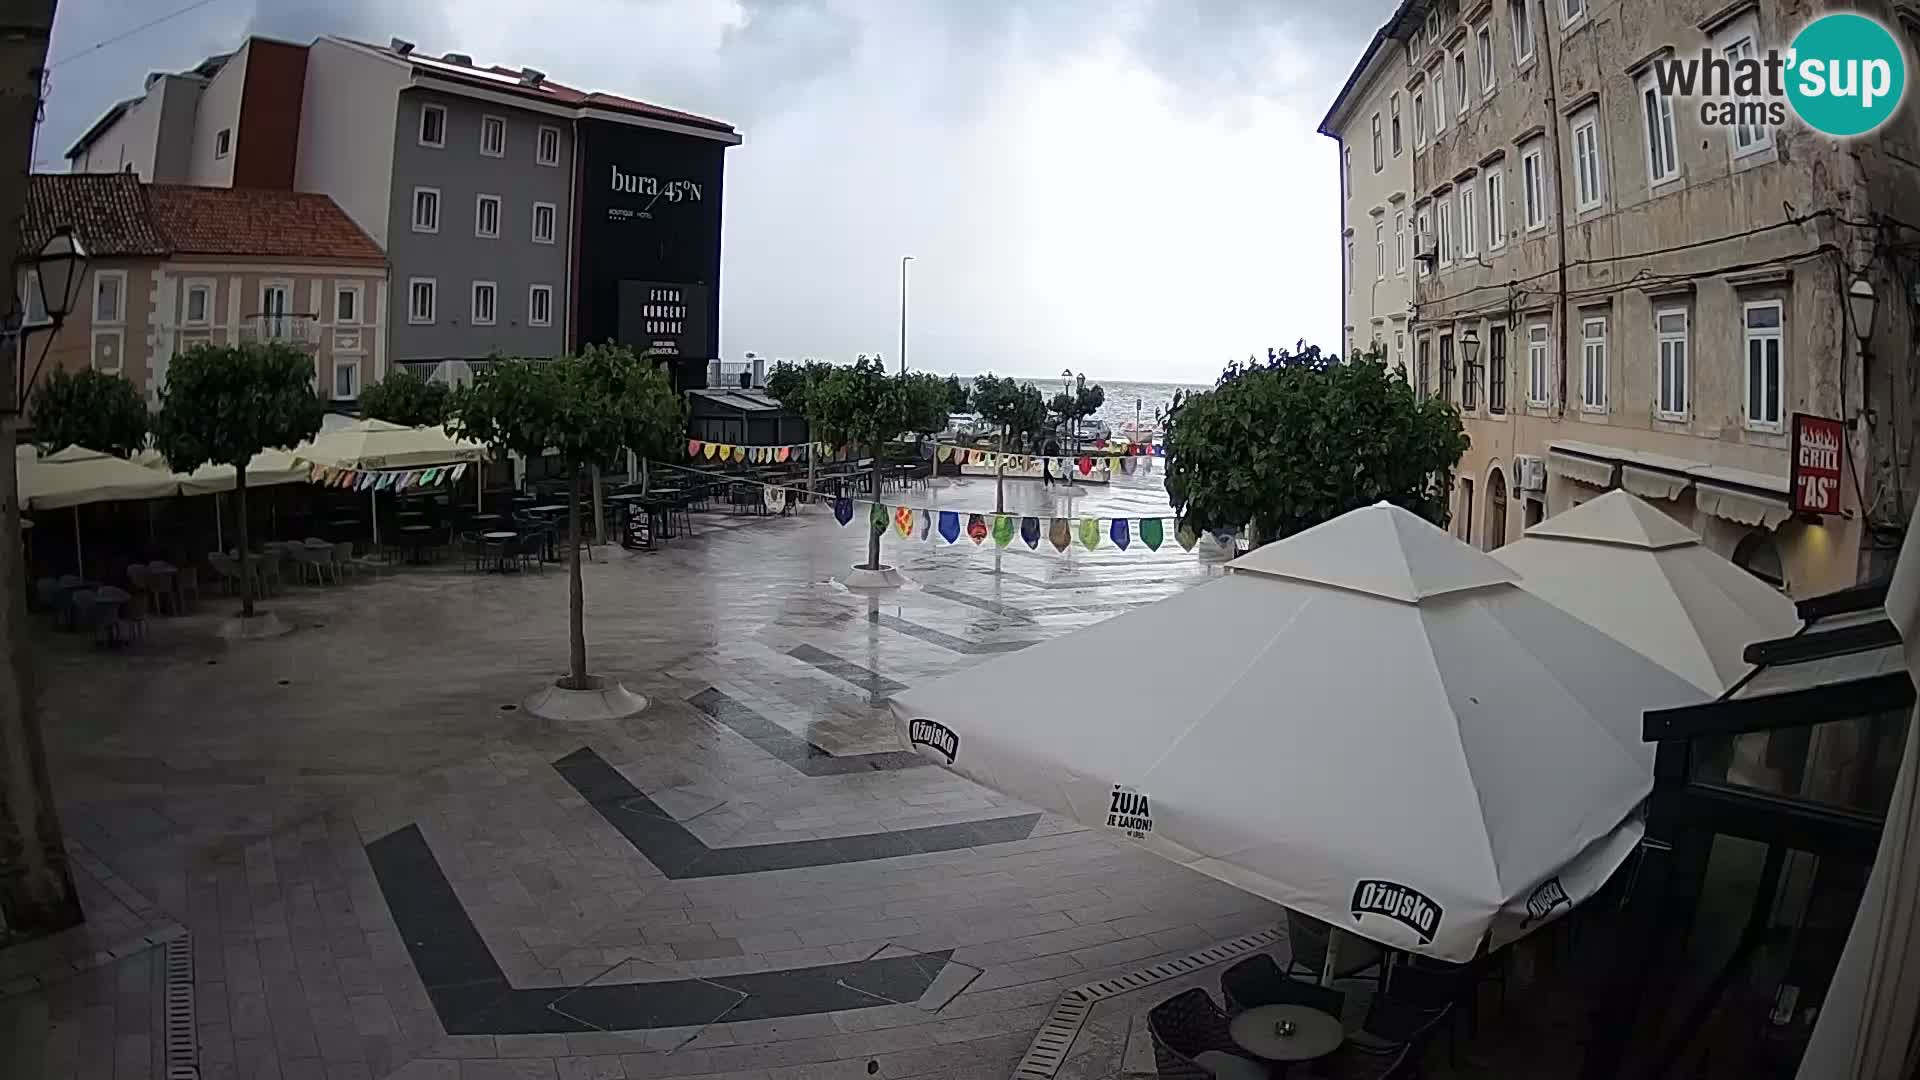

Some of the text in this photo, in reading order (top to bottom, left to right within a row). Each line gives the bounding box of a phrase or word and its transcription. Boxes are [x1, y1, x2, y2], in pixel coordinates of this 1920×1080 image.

[611, 165, 657, 195] bura
[650, 289, 680, 302] EXTRA
[643, 304, 687, 319] KONCERT
[646, 320, 683, 335] GODINE
[1799, 447, 1839, 471] GRILL
[912, 720, 956, 755] Ožujsko
[1110, 784, 1150, 818] ŽUJA
[1106, 814, 1153, 832] JE ZAKON!
[1359, 881, 1436, 932] Ožujsko
